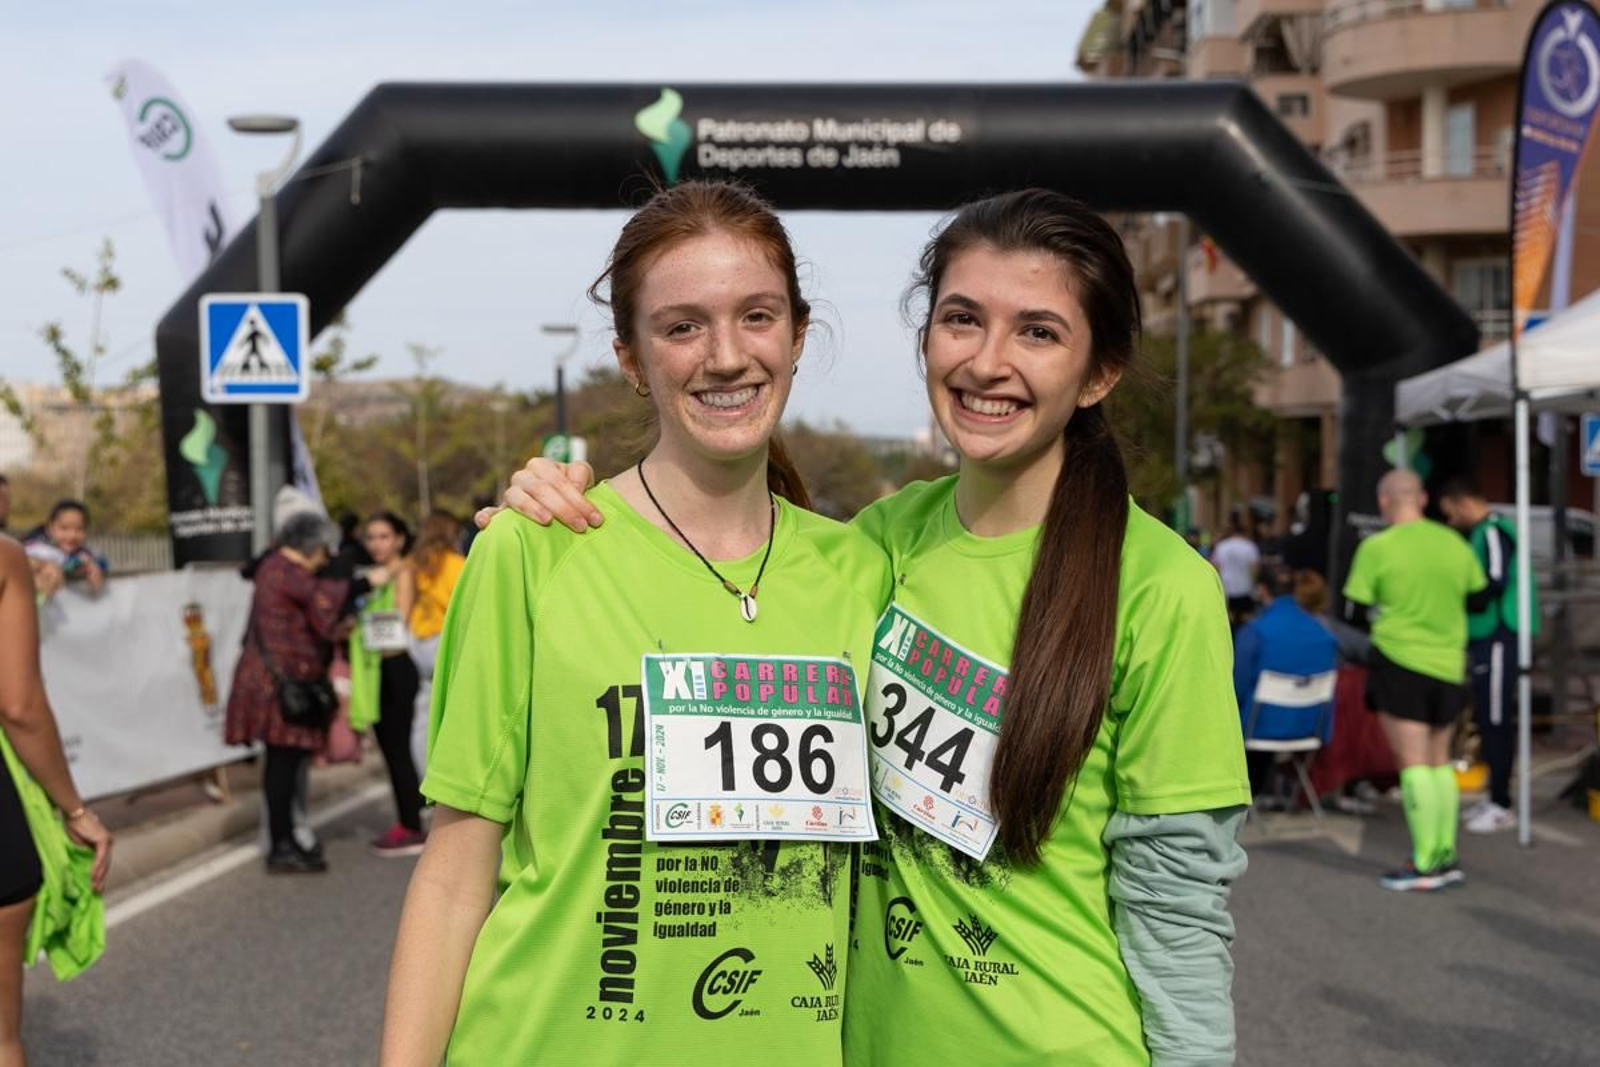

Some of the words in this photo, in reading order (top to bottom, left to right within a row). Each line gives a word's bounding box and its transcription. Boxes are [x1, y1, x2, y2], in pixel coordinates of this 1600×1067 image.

[698, 118, 809, 142] Patronato
[813, 118, 925, 145] Municipal
[928, 119, 961, 142] de
[698, 143, 804, 171] Deportes
[806, 144, 839, 168] de
[841, 143, 901, 168] Jaén
[878, 613, 917, 662] XI
[916, 630, 1008, 697] CARRER
[658, 660, 707, 700] XI
[874, 652, 887, 664] por
[895, 663, 904, 674] No
[904, 670, 927, 690] violencia
[926, 685, 934, 696] de
[934, 691, 957, 711] género
[957, 705, 963, 715] y
[964, 709, 973, 719] la
[907, 648, 1001, 718] POPULA
[712, 681, 853, 707] POPULAR
[596, 684, 646, 759] 17
[669, 704, 685, 714] por
[689, 703, 698, 713] la
[700, 704, 714, 713] No
[716, 704, 755, 715] violencia
[757, 706, 768, 716] de
[771, 706, 802, 718] género
[805, 709, 812, 718] y
[814, 707, 822, 717] la
[823, 708, 853, 720] igualdad
[870, 683, 975, 793] 344
[704, 721, 835, 795] 186
[670, 810, 692, 820] CSIF
[656, 857, 682, 873] por
[684, 856, 698, 872] la
[700, 855, 719, 871] NO
[596, 768, 645, 1003] noviembre
[655, 878, 721, 893] violencia
[723, 877, 740, 893] de
[654, 899, 706, 917] género
[708, 902, 717, 917] y
[718, 900, 732, 915] la
[653, 921, 717, 940] igualdad
[888, 915, 923, 942] CSIF
[943, 954, 971, 969] AJA
[974, 961, 1020, 976] RURAL
[707, 969, 763, 996] CSIF
[586, 1005, 646, 1024] 2024
[739, 1008, 761, 1017] Jaén
[791, 996, 822, 1009] CAJA
